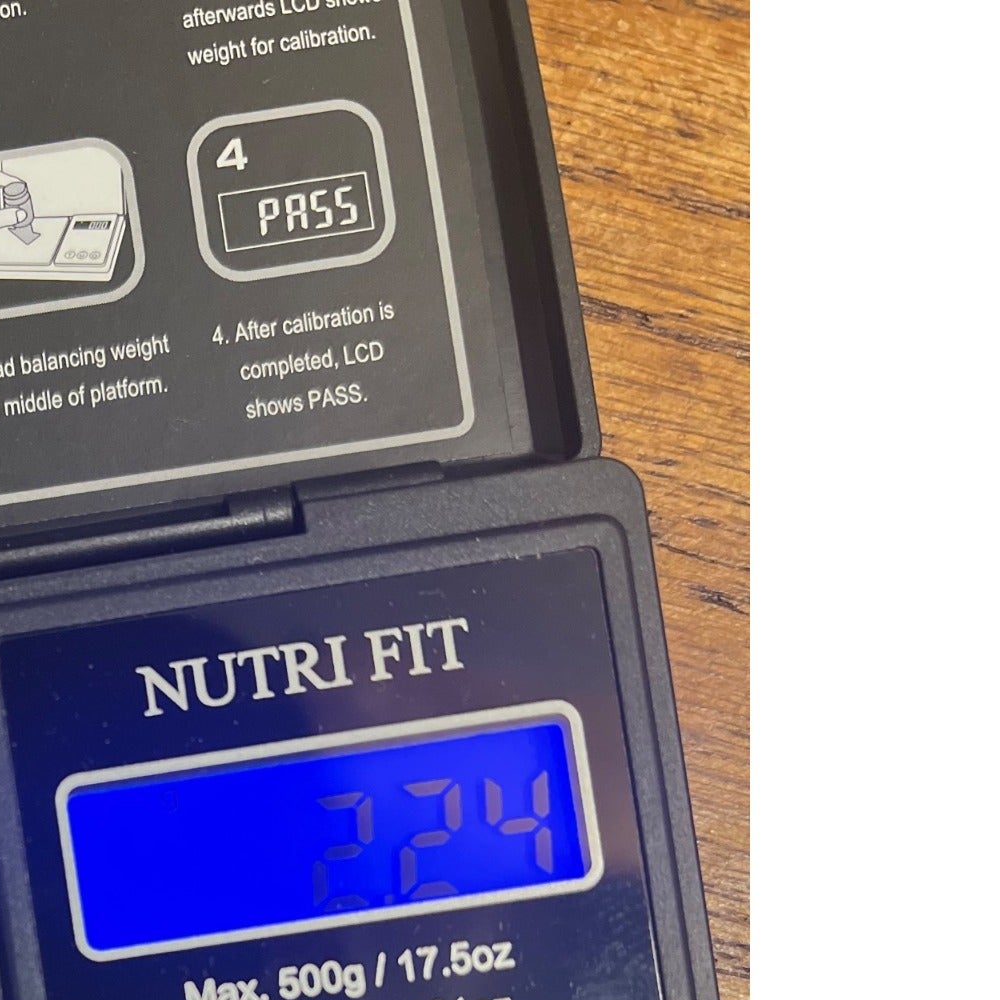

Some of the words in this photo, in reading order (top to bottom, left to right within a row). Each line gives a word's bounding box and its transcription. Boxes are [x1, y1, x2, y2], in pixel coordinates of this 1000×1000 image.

[0, 1, 27, 19] on.
[182, 4, 276, 29] afterwards
[187, 38, 248, 66] weight
[250, 36, 275, 57] for
[279, 24, 376, 52] calibration.
[215, 137, 249, 171] 4
[257, 185, 359, 236] PASS
[211, 326, 230, 345] 4.
[235, 317, 277, 343] After
[281, 304, 375, 336] calibration
[378, 301, 395, 322] is
[20, 343, 106, 376] balancing
[110, 333, 170, 364] weight
[239, 347, 339, 382] completed,
[343, 341, 385, 367] LCD
[3, 387, 63, 417] middle
[67, 385, 85, 407] of
[89, 375, 168, 408] platform.
[245, 393, 304, 420] shows
[308, 384, 368, 410] PASS.
[136, 635, 354, 718] NUTRI
[364, 617, 470, 682] FIT
[312, 770, 553, 912] 2.24
[278, 958, 367, 999] 500g
[375, 953, 387, 987] /
[397, 940, 516, 984] 17.5oz
